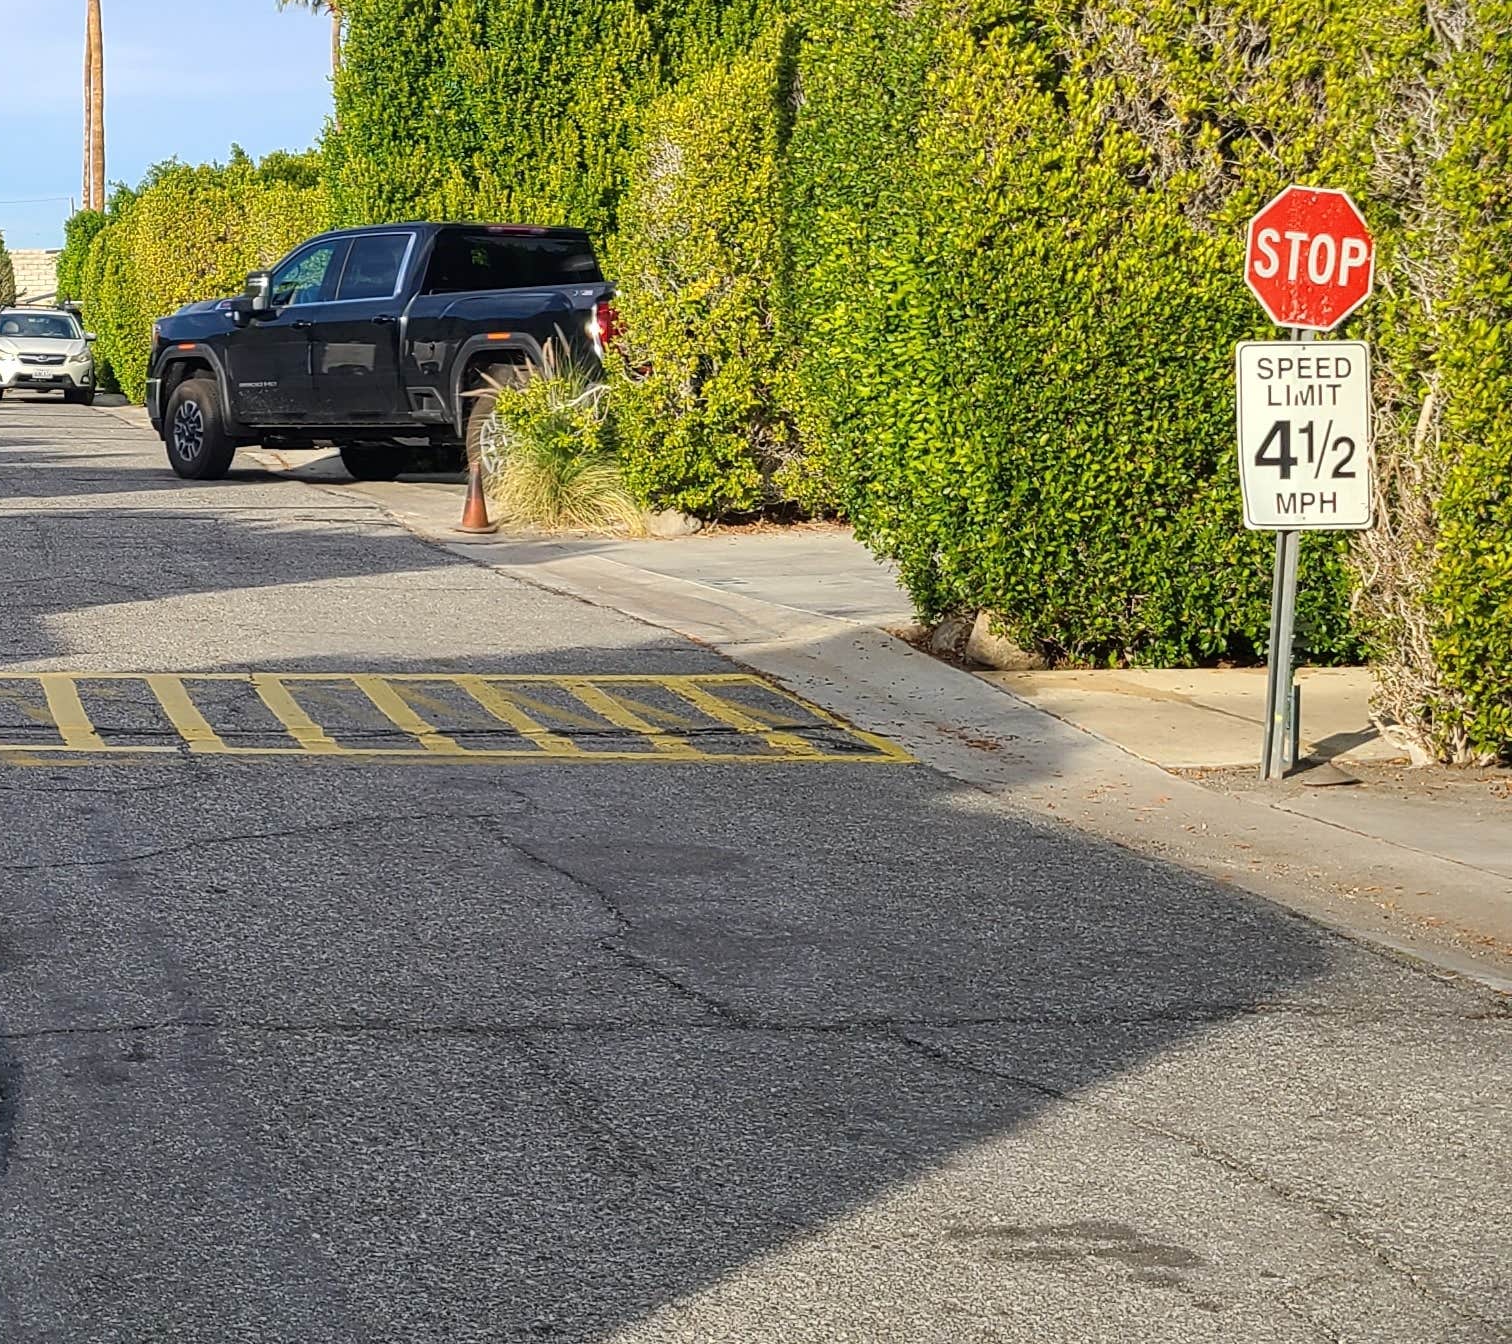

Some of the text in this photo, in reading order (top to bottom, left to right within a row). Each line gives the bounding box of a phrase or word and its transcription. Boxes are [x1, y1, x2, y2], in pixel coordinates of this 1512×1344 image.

[1255, 228, 1366, 286] STOP
[1257, 357, 1352, 380] SPEED
[1267, 384, 1342, 406] LIMIT
[1276, 491, 1337, 514] MPH
